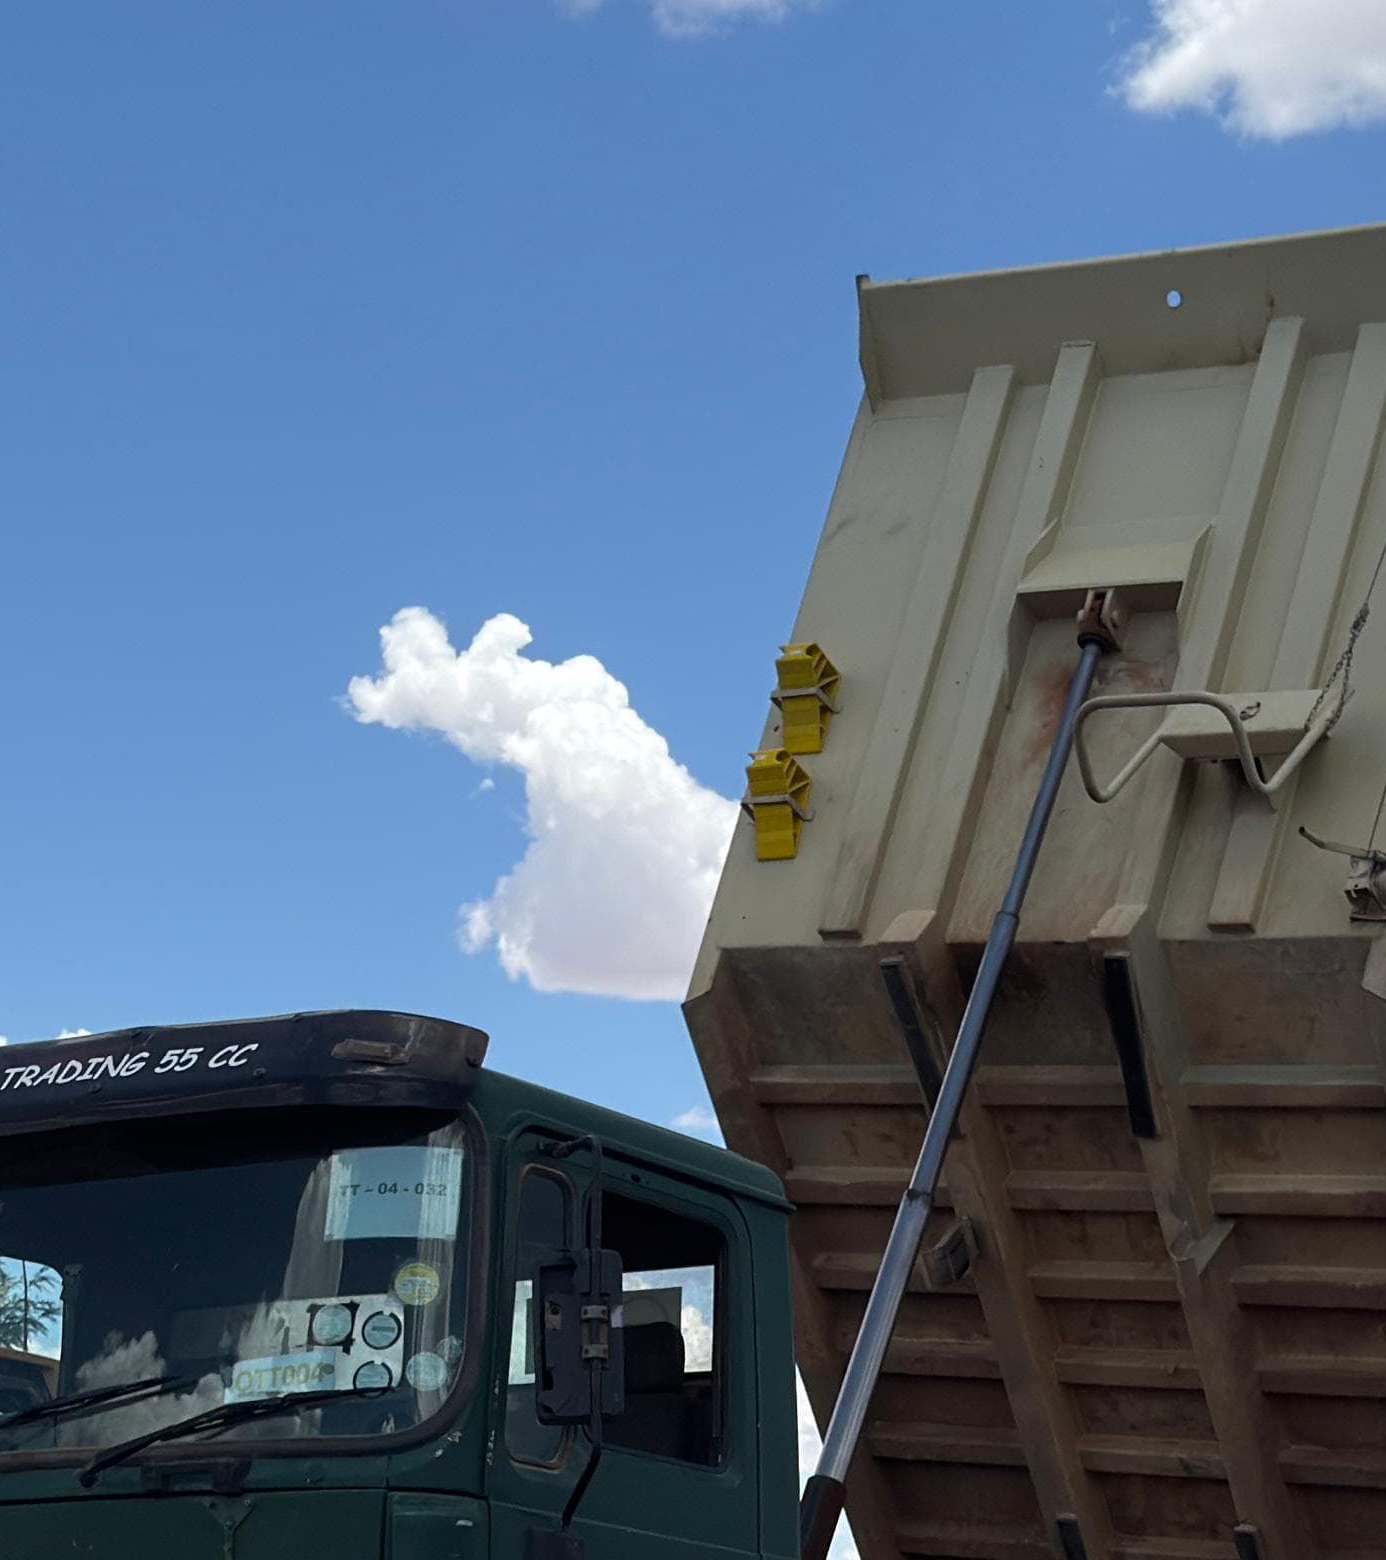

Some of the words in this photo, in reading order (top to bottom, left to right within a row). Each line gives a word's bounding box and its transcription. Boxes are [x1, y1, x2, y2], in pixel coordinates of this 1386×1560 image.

[0, 1052, 150, 1092] TRADING
[154, 1047, 204, 1075] 55
[208, 1043, 260, 1069] CC
